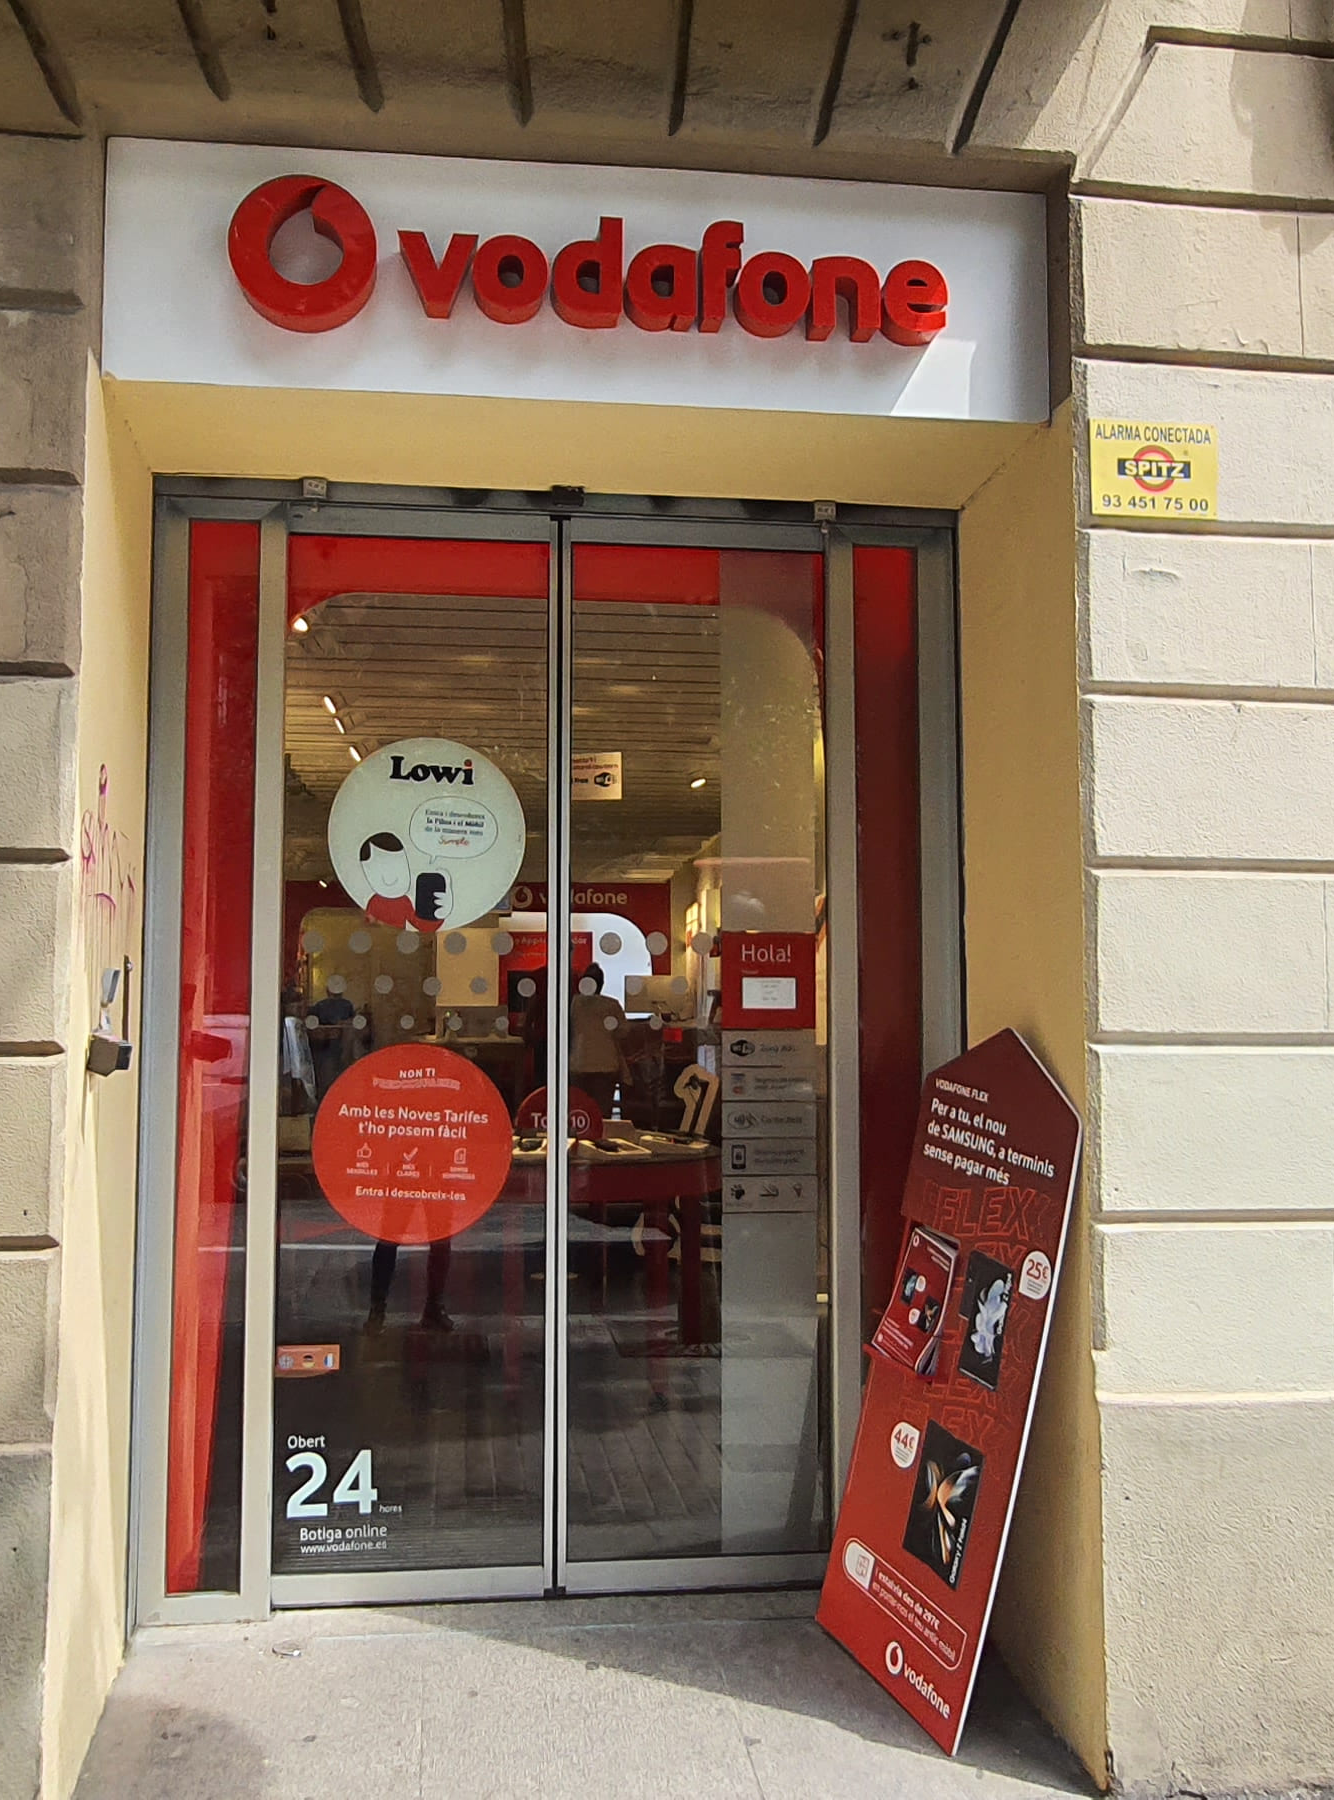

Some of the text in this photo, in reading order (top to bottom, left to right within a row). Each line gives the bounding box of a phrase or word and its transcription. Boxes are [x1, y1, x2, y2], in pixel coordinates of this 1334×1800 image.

[398, 217, 949, 346] vodafone
[1095, 424, 1211, 444] ALARMA CONECTADA
[1124, 460, 1185, 478] SPITZ
[1102, 494, 1209, 512] 93 451 75 00
[389, 755, 475, 786] Lowi
[539, 888, 628, 905] vafone
[741, 943, 791, 963] Hola!
[399, 1067, 436, 1079] NON TI
[935, 1078, 989, 1103] VODAFONE FLEX
[338, 1104, 489, 1124] Amb les Noves Tarifes
[571, 1115, 586, 1128] 10
[931, 1098, 949, 1116] Per
[949, 1110, 956, 1119] a
[973, 1113, 984, 1129] el
[985, 1118, 1007, 1136] nou
[358, 1121, 467, 1139] t'ho posem fàcil
[927, 1119, 1055, 1178] de SAMSUNG, a terminis
[923, 1143, 1011, 1185] sense pagar més
[355, 1185, 384, 1197] Entra
[390, 1187, 466, 1201] descobreix-les
[932, 1186, 1036, 1241] FLEX
[1026, 1259, 1049, 1280] 25€
[287, 1435, 326, 1449] Obert
[285, 1449, 402, 1519] 24 hores
[299, 1524, 387, 1543] Botiga online
[300, 1539, 387, 1554] www.vodafone.es
[949, 1551, 962, 1584] Galaxy
[904, 1660, 950, 1720] vodafone
